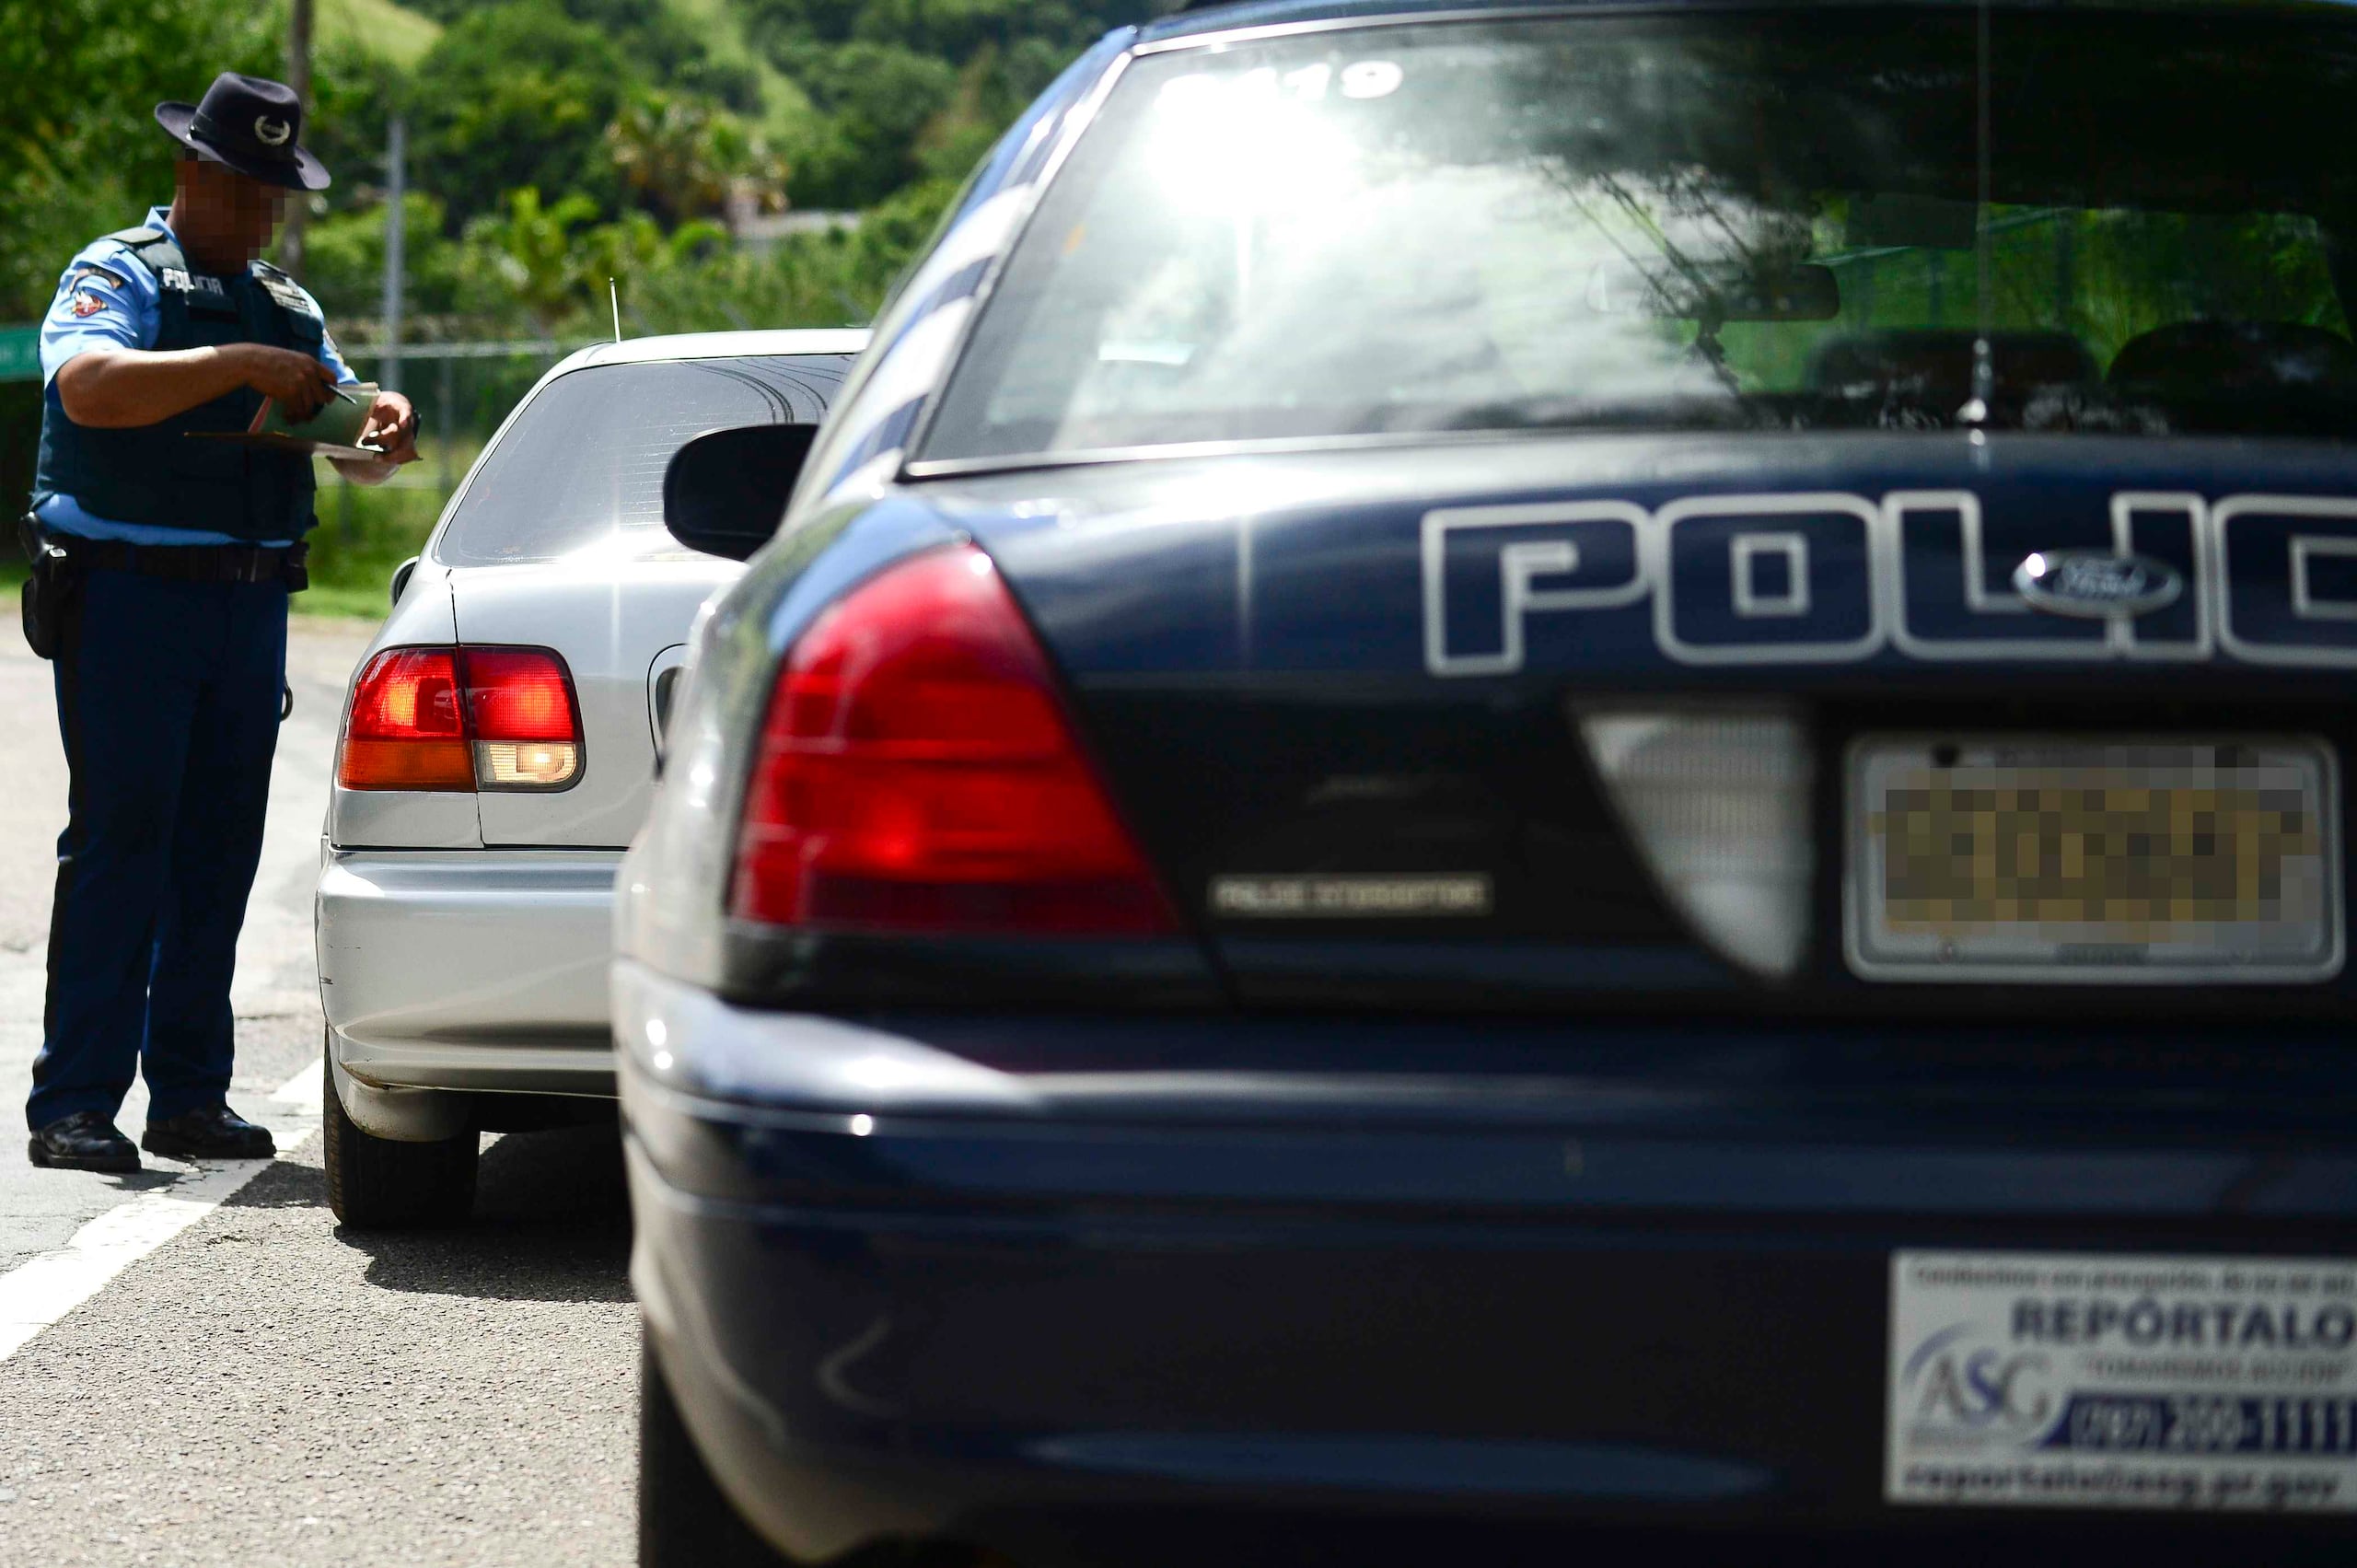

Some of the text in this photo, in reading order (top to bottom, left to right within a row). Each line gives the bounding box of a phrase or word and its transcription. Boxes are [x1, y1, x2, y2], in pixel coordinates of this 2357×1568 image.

[163, 268, 224, 296] POLICIA
[2011, 1295, 2357, 1347] REPÓRTALO
[1918, 1349, 2051, 1426] ASG
